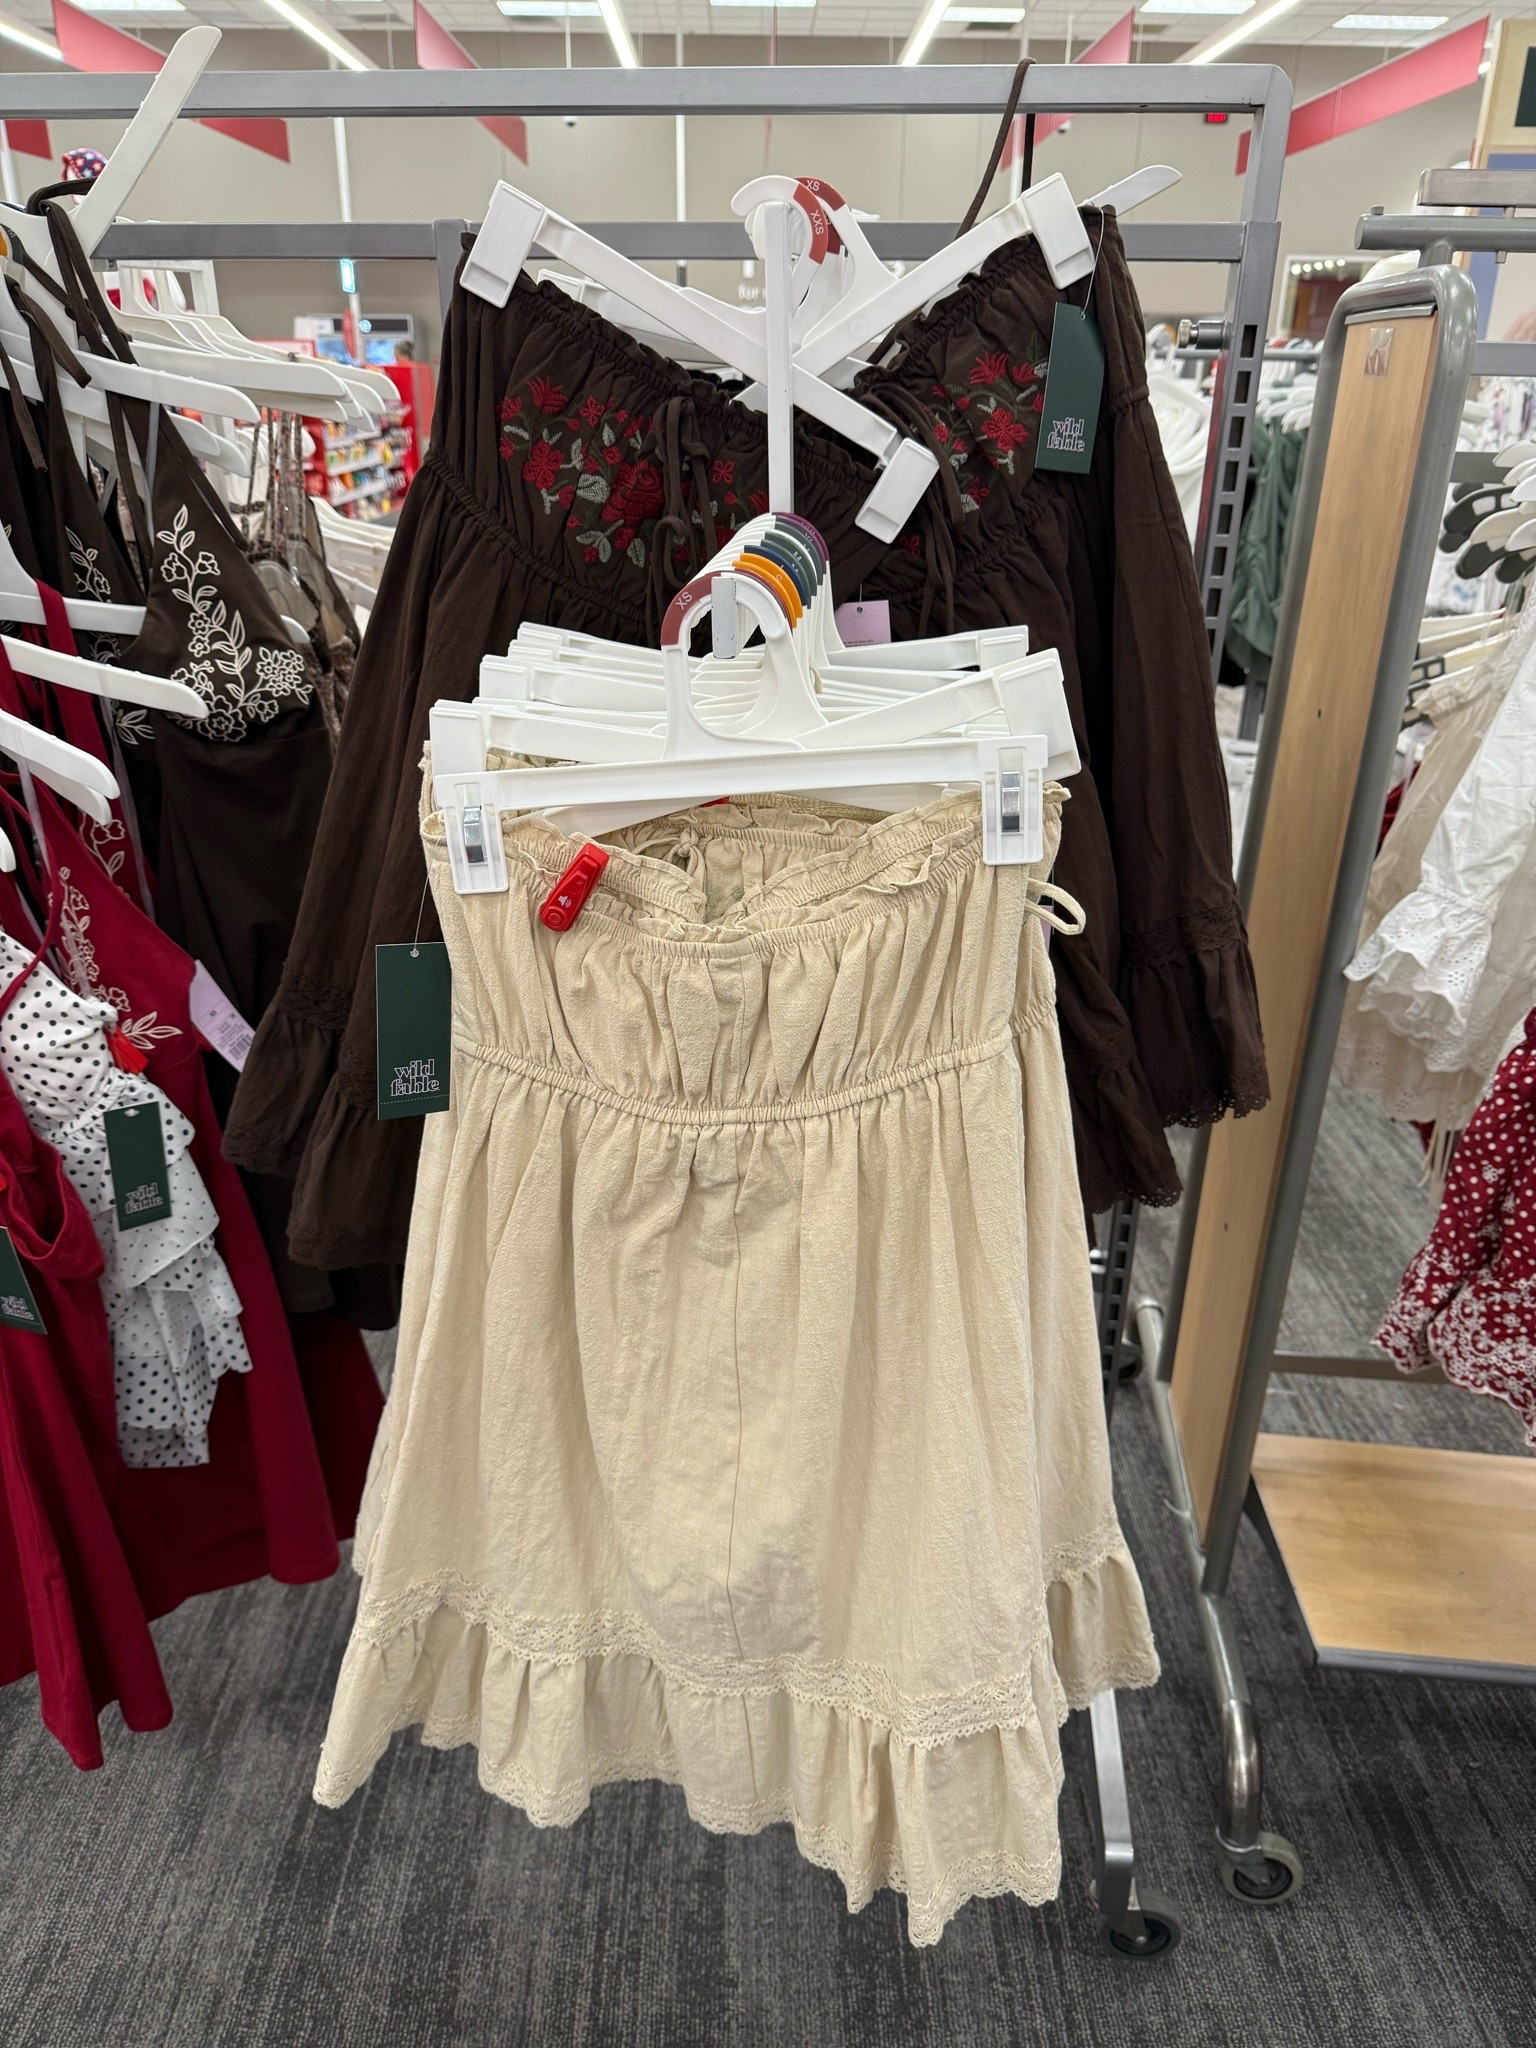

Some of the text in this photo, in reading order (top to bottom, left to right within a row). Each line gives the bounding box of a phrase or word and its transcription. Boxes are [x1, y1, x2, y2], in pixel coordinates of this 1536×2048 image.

[806, 179, 820, 191] XS
[810, 209, 824, 235] XXS
[1052, 416, 1085, 436] wild
[1046, 431, 1085, 452] fable
[675, 591, 693, 610] XS
[393, 1058, 435, 1078] wild
[390, 1075, 440, 1096] fable
[126, 1182, 159, 1201] wild
[125, 1196, 164, 1214] fable
